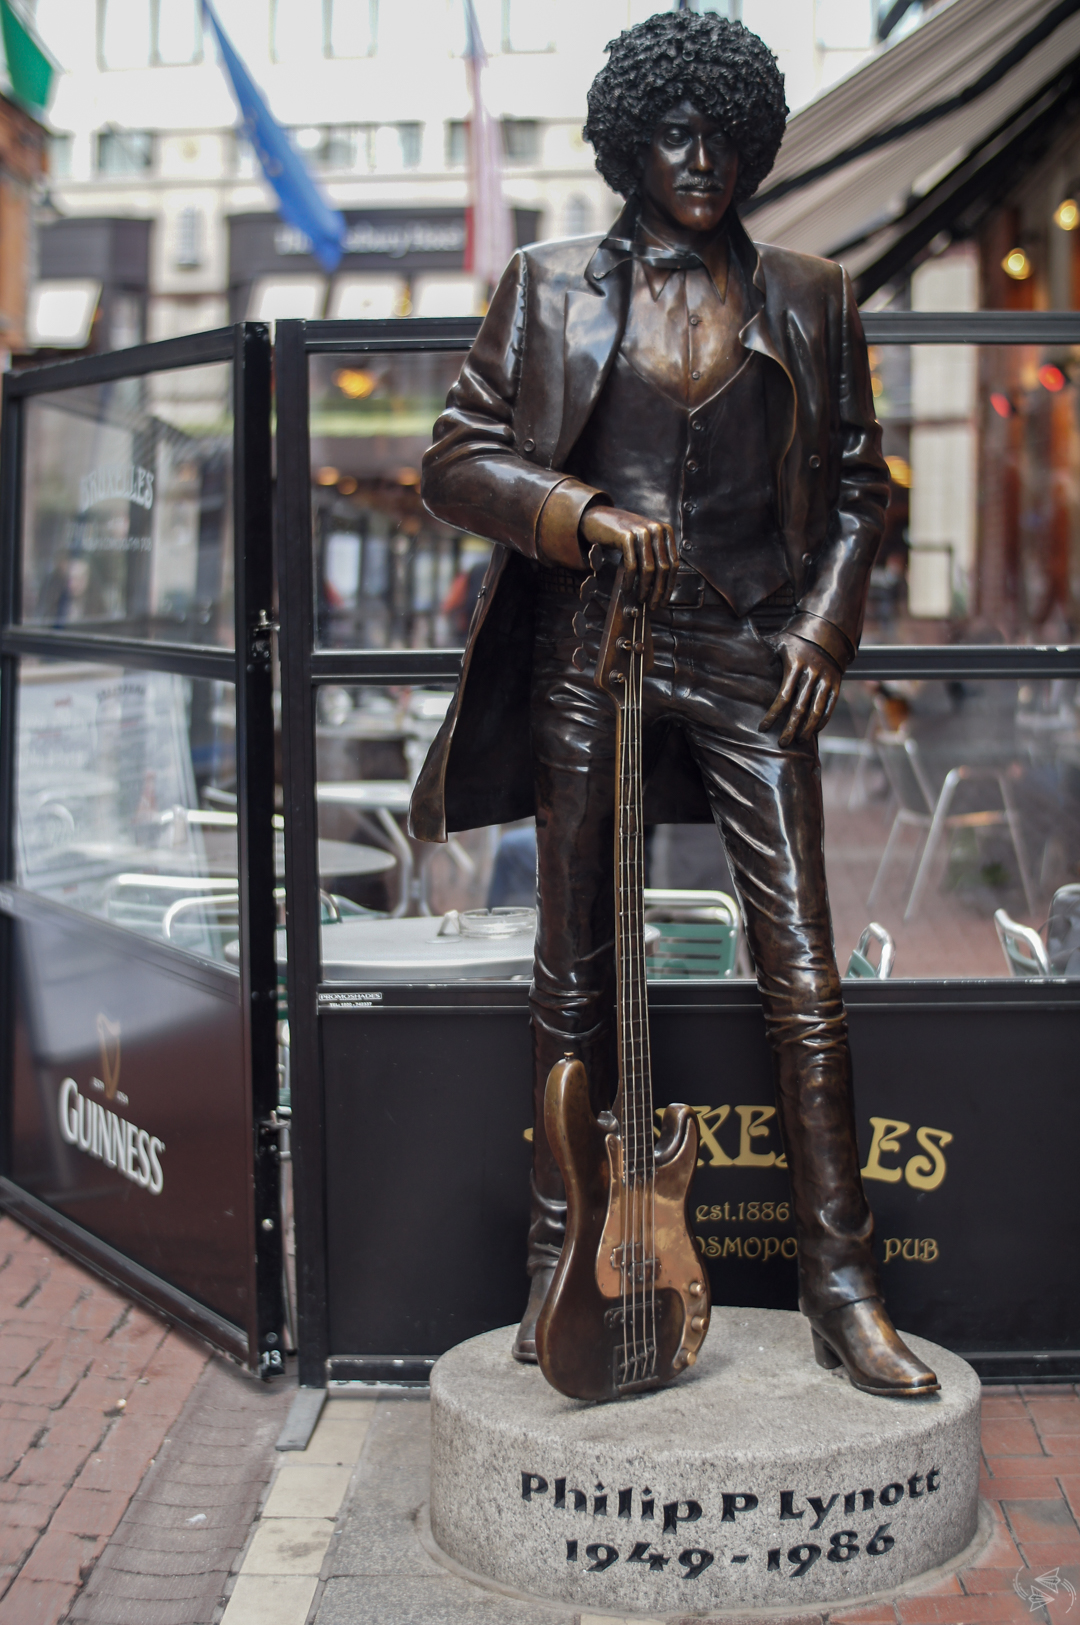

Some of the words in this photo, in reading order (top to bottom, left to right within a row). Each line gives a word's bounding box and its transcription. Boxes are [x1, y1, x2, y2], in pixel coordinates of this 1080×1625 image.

[59, 1077, 164, 1195] GUINNESS
[883, 1238, 939, 1263] PUB
[521, 1471, 702, 1535] Philip
[720, 1492, 759, 1522] P
[779, 1464, 942, 1531] Lynott
